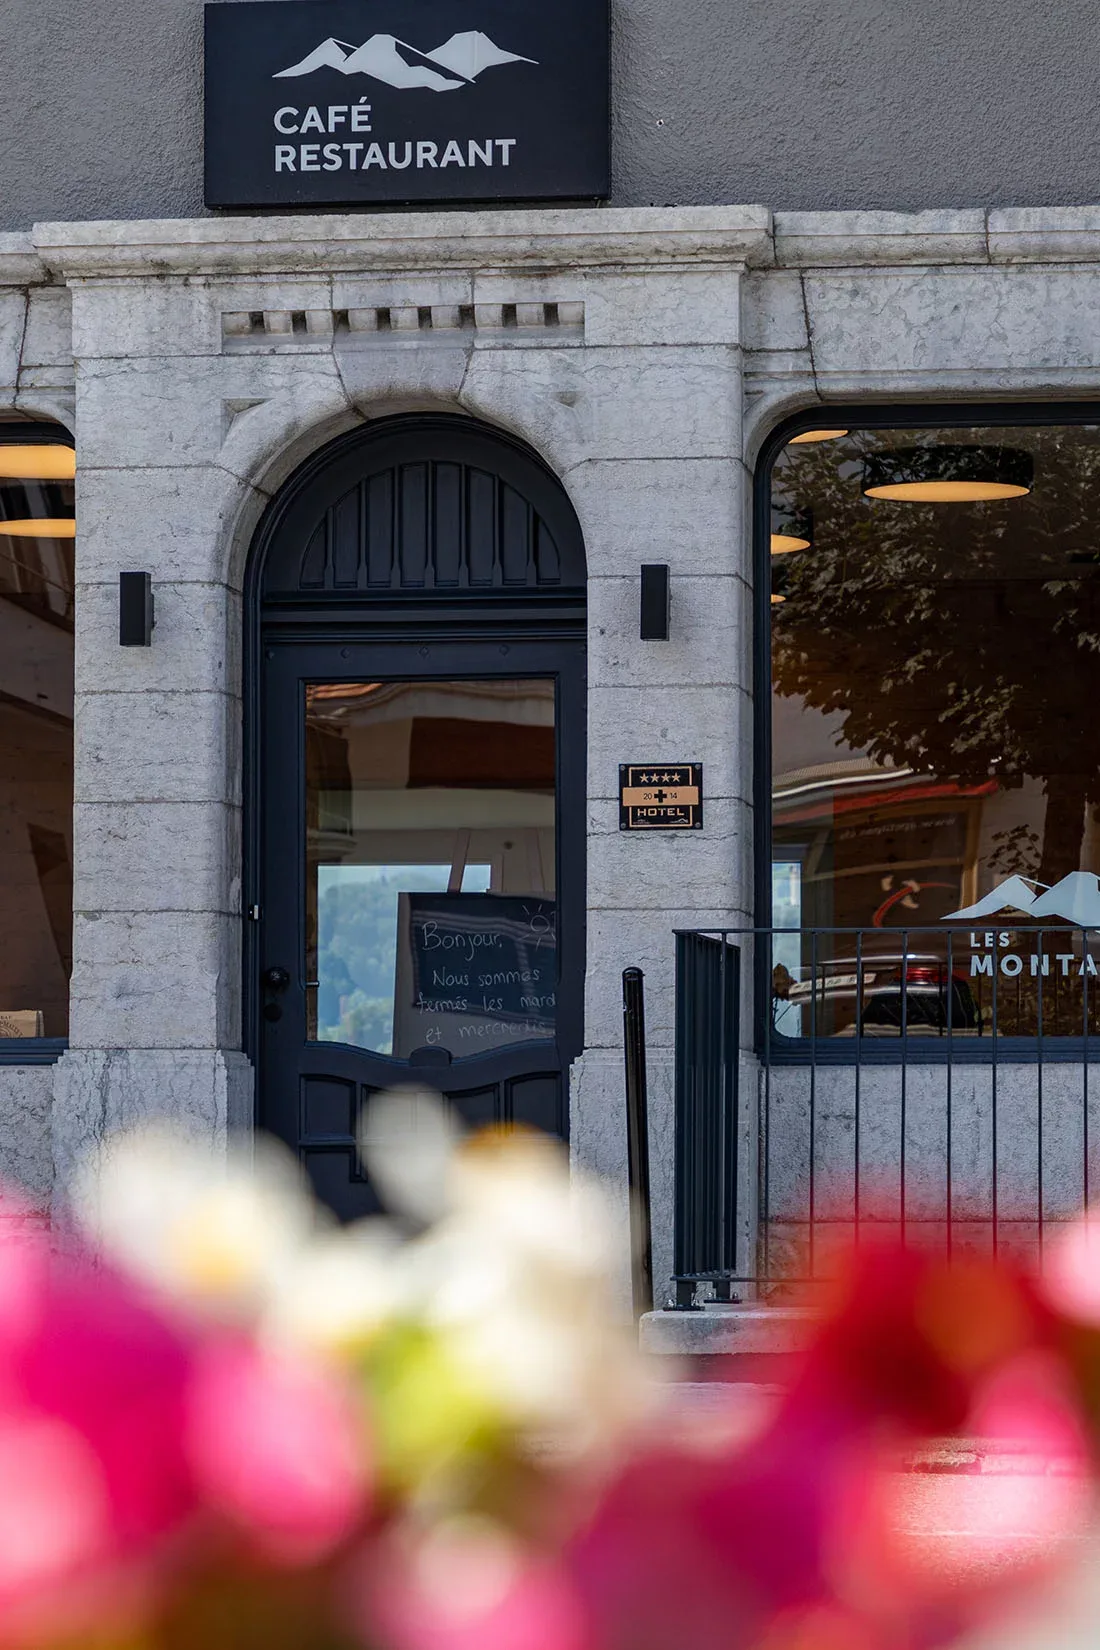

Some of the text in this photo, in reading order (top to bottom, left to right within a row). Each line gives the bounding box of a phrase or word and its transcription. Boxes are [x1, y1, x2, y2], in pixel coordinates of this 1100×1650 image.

[274, 96, 372, 134] CAFÉ
[274, 139, 517, 172] RESTAURANT
[637, 808, 685, 816] HOTEL
[970, 932, 1010, 948] LES
[970, 953, 1098, 977] MONTA
[433, 966, 540, 987] Nous sommes
[416, 991, 468, 1014] fermés
[482, 995, 503, 1012] les
[425, 1025, 442, 1044] et
